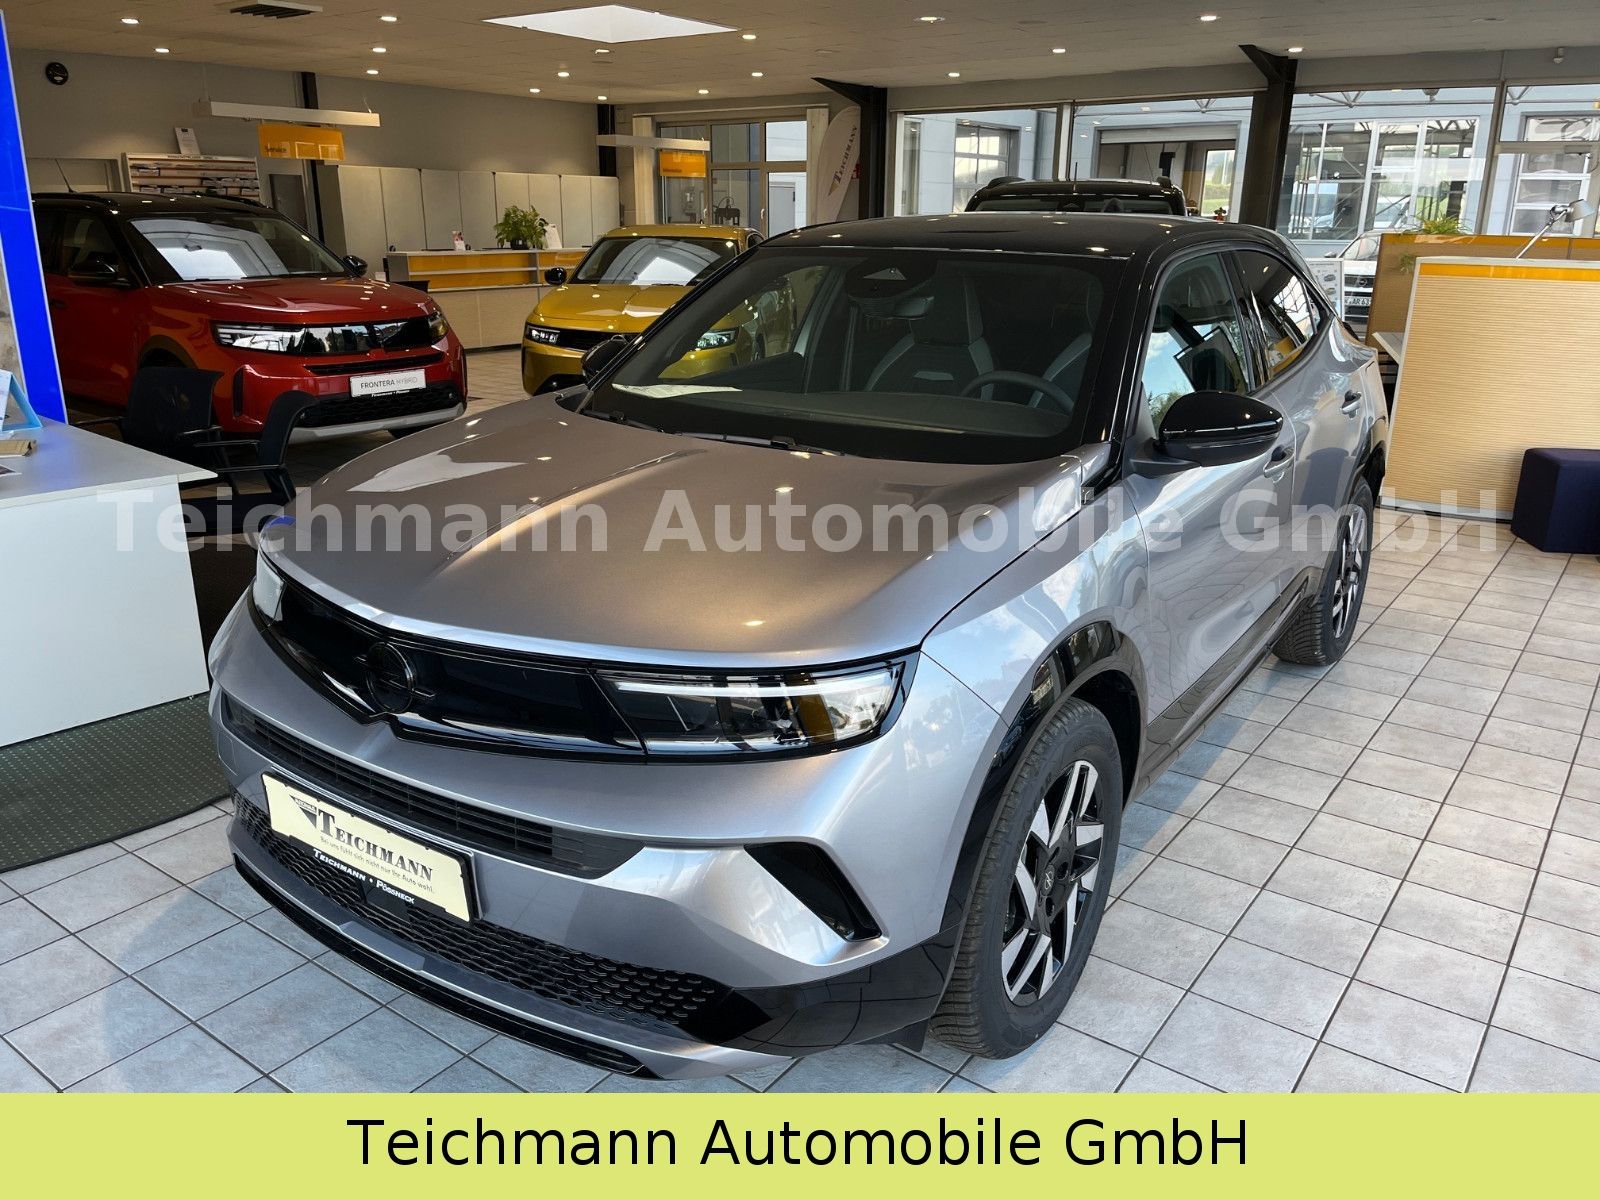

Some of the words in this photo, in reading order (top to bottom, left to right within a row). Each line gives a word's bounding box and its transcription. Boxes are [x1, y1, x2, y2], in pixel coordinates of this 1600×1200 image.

[361, 379, 395, 389] FRONTERA
[396, 376, 418, 386] HYBRID
[318, 808, 434, 882] TEICHMANN
[313, 848, 366, 881] TEICHMANN
